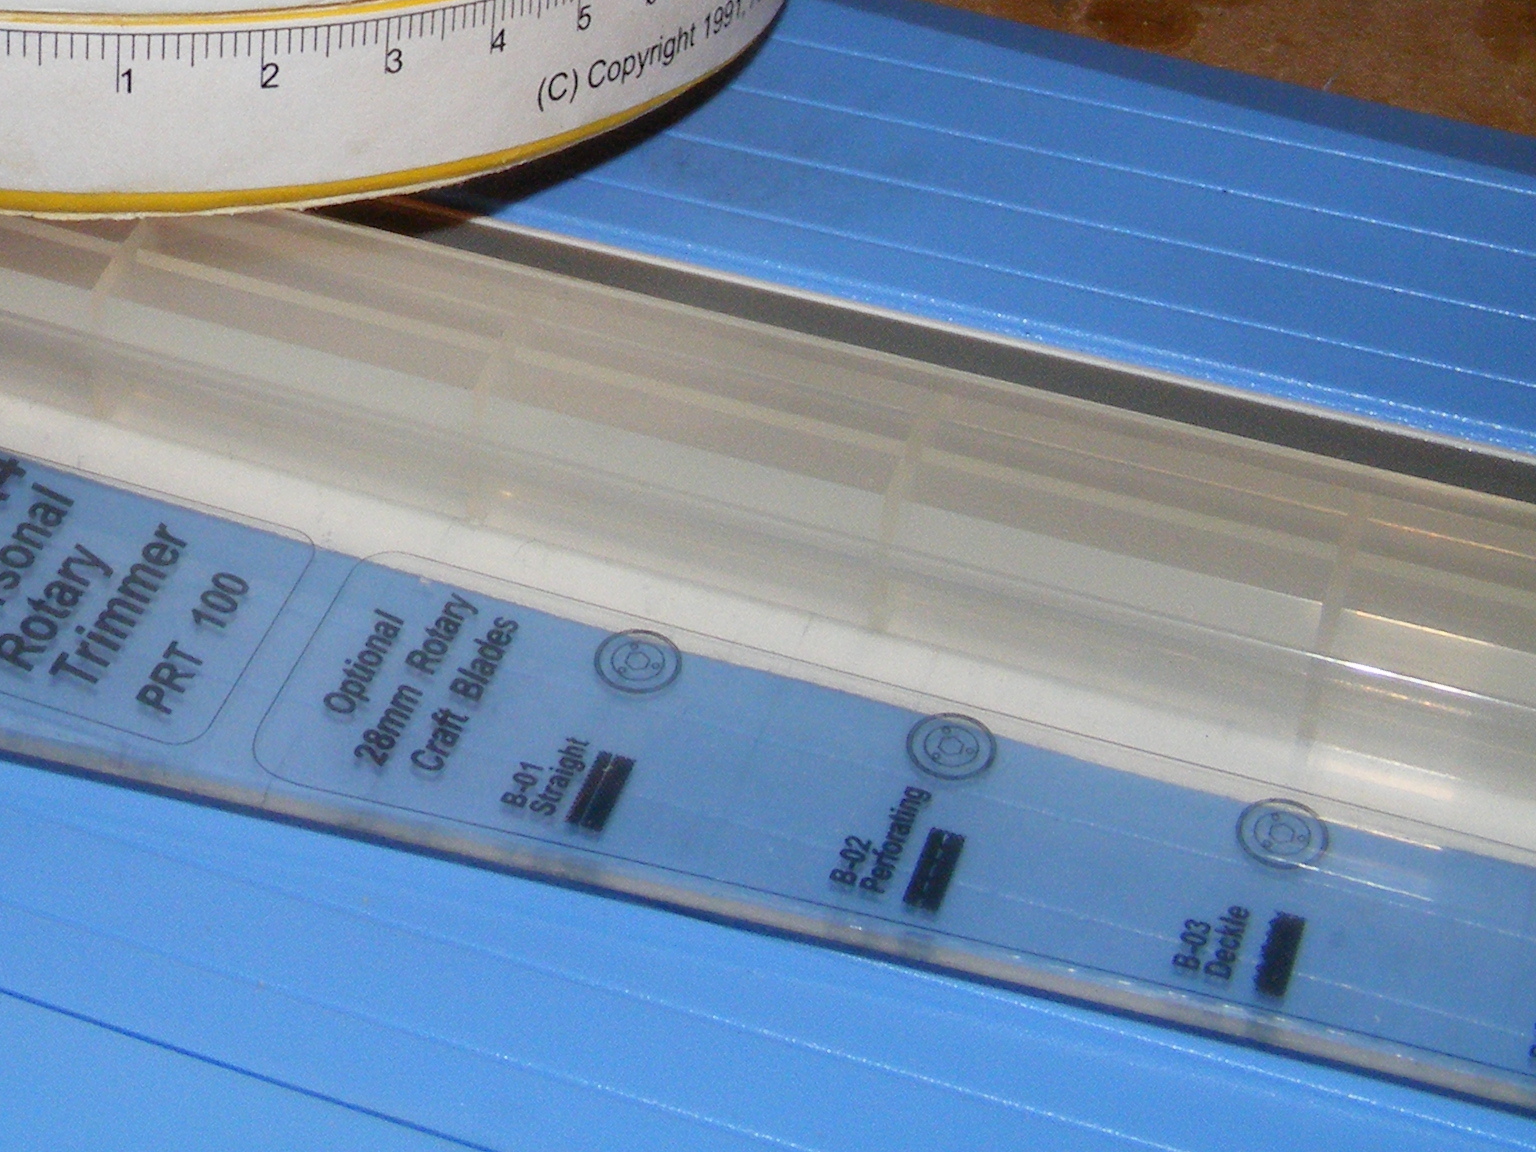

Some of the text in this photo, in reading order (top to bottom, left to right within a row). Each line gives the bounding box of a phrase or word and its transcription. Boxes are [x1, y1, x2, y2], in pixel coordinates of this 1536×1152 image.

[120, 68, 135, 94] 1
[262, 62, 280, 90] 2
[386, 49, 404, 75] 3
[492, 28, 507, 52] 4
[577, 4, 592, 31] 5
[537, 68, 579, 112] (C)
[587, 22, 696, 89] Copyright
[48, 521, 188, 685] Trimmer
[135, 571, 251, 716] PRT 100
[322, 608, 405, 716] Optional
[353, 592, 480, 768] 28mm Rotary
[409, 616, 520, 772] Craft Blades
[500, 760, 545, 809] B-01
[528, 736, 591, 817] Straight
[829, 834, 873, 885] B-02
[858, 785, 933, 894] Perforating
[1171, 918, 1212, 971] B-03
[1202, 904, 1251, 981] Deckle
